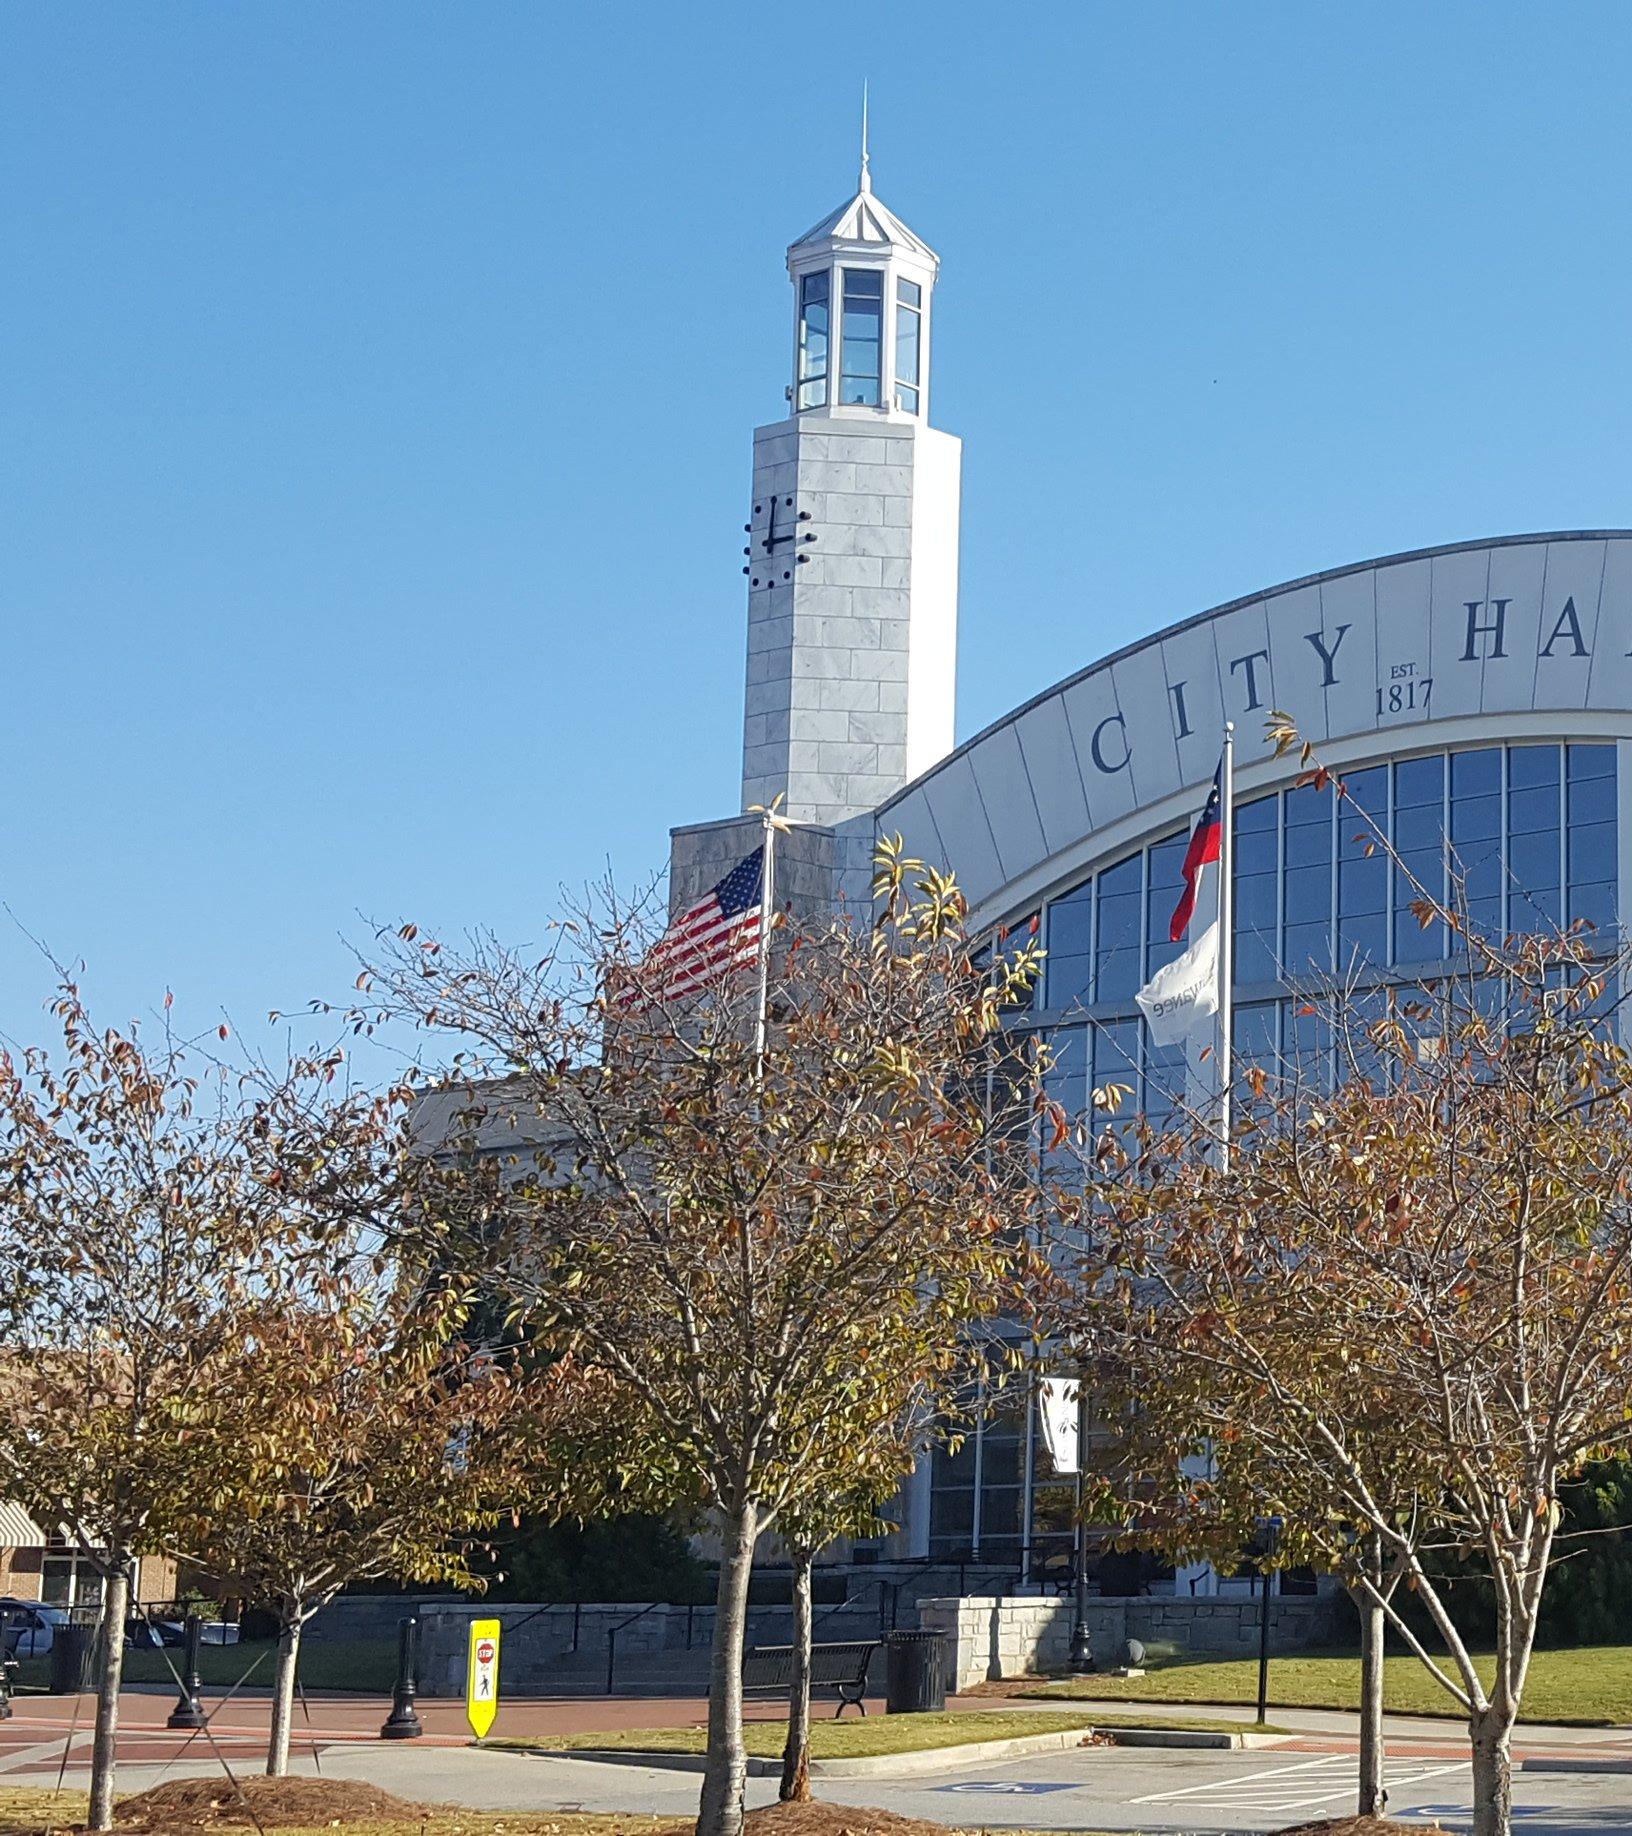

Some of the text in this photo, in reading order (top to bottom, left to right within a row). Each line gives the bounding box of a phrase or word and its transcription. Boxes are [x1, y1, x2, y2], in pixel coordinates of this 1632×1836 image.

[1391, 662, 1419, 679] EST.
[1090, 623, 1353, 775] CITY
[1376, 678, 1433, 716] 1817
